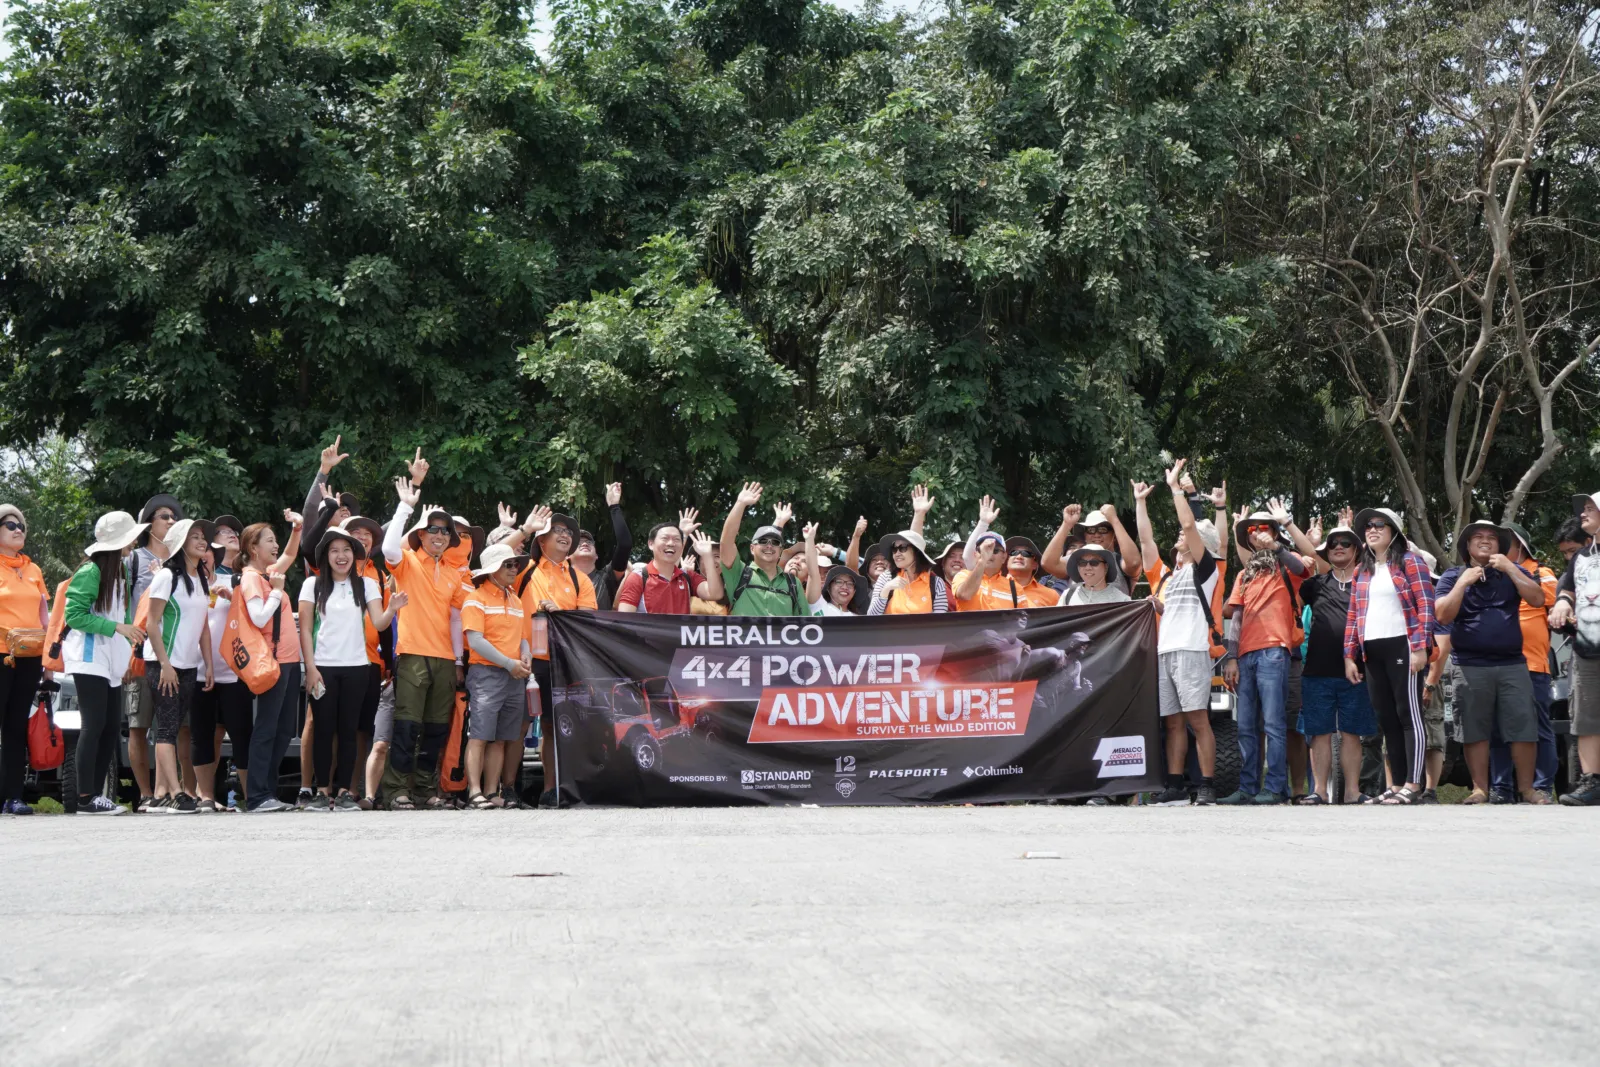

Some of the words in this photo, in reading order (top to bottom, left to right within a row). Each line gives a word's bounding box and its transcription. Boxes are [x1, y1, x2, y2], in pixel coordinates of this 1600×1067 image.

[680, 624, 824, 646] MERALCO
[681, 655, 750, 687] 4x4
[762, 653, 921, 686] POWER
[768, 688, 1015, 726] ADVENTURE
[856, 725, 905, 735] SURVIVE
[909, 724, 931, 733] THE
[934, 723, 964, 732] WILD
[968, 721, 1016, 732] EDITION
[1112, 746, 1143, 754] MERALCO
[1109, 753, 1143, 761] CORPORATE
[835, 755, 856, 773] 12
[755, 770, 811, 781] STANDARD
[869, 768, 948, 778] PACSPORTS
[974, 765, 1024, 777] Columbia
